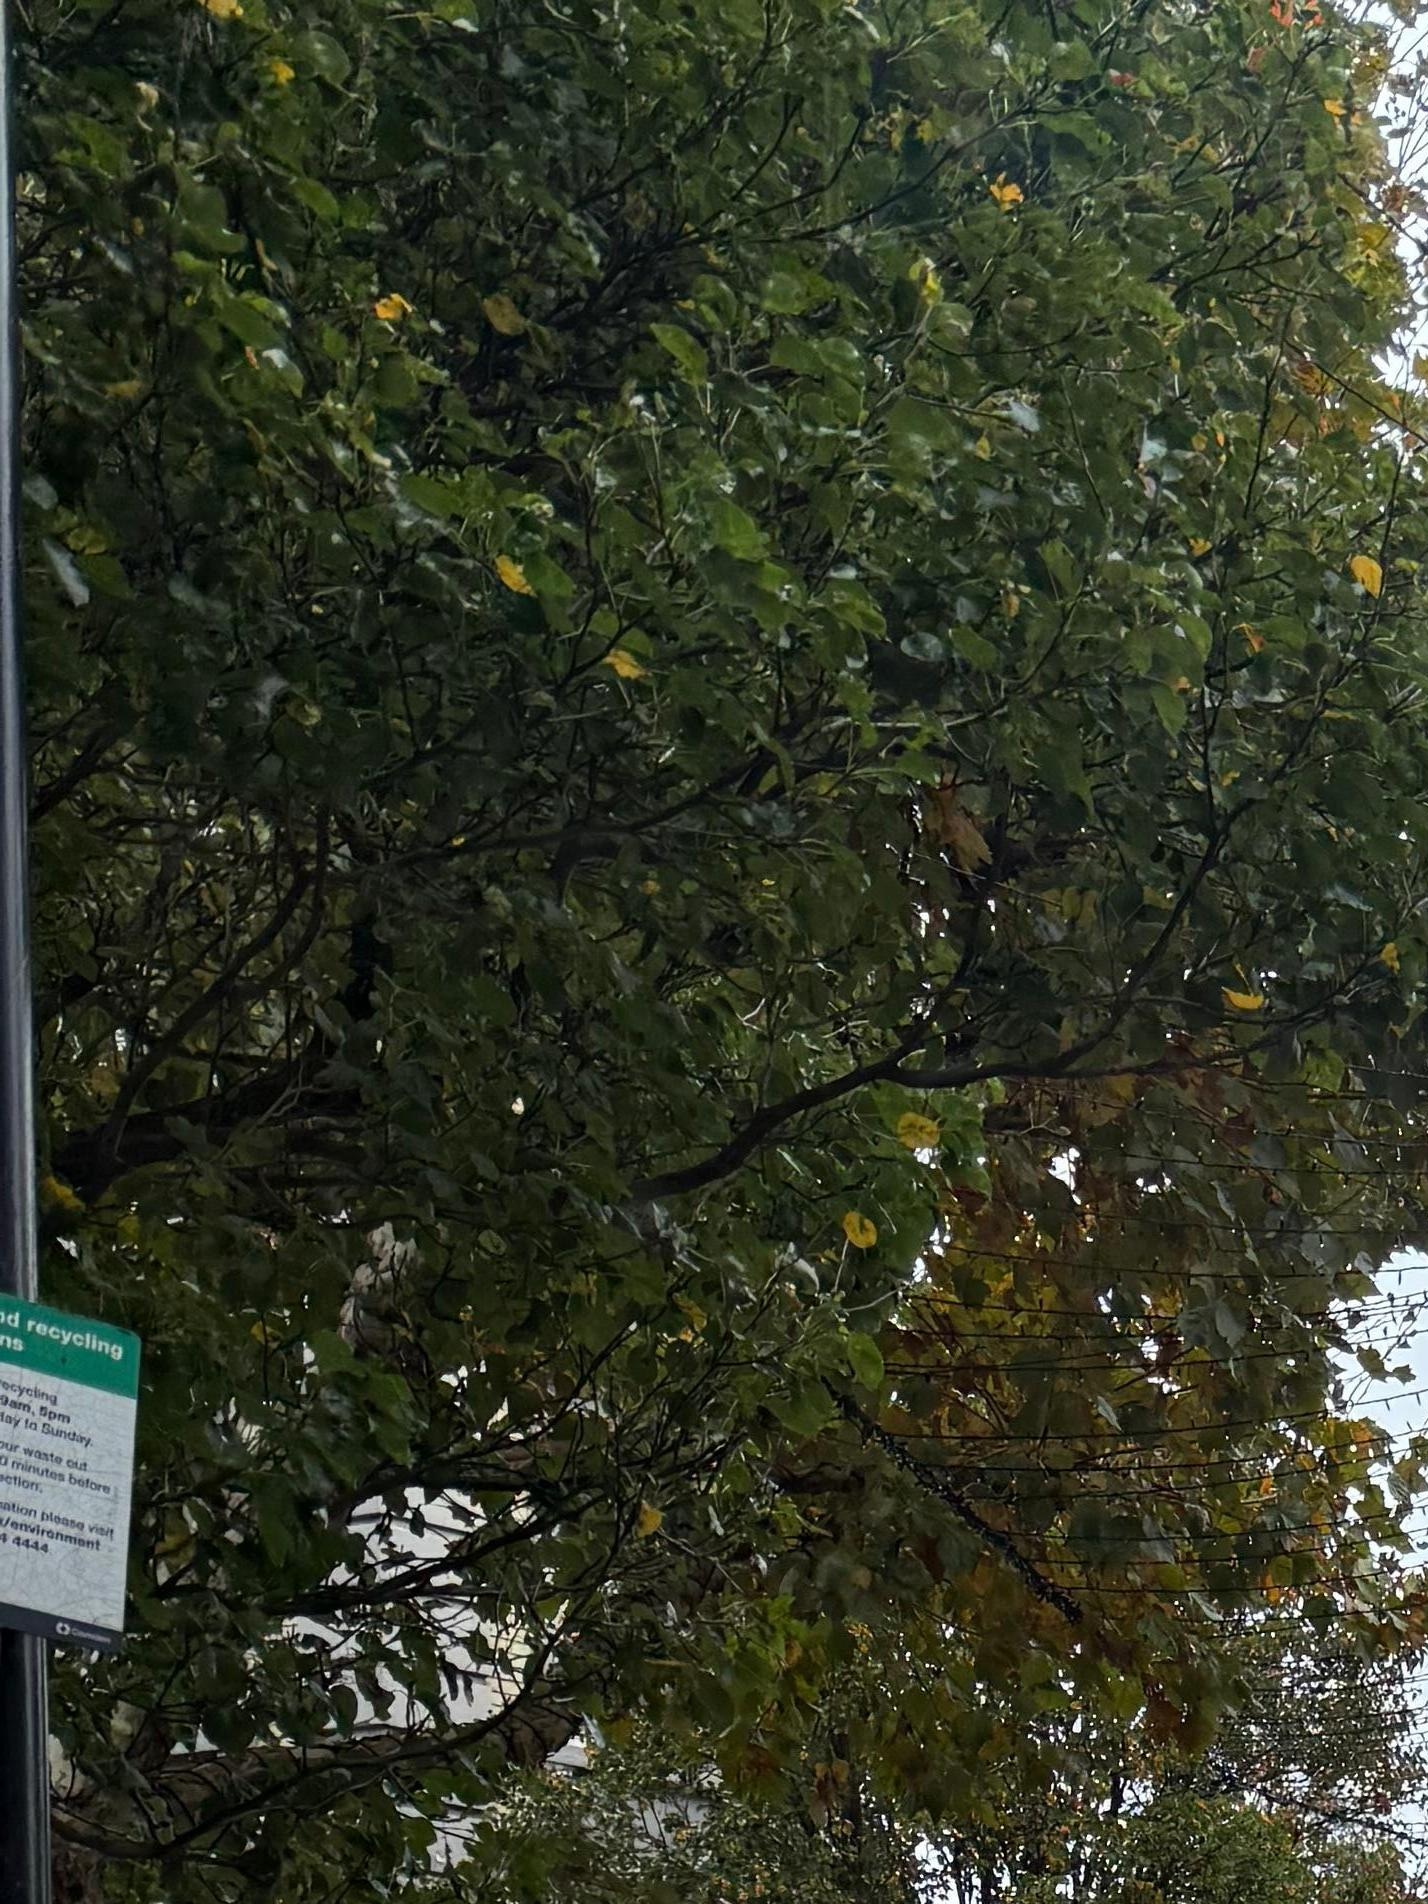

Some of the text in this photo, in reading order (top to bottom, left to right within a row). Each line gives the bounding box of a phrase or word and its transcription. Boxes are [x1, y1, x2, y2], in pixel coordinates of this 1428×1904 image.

[27, 1319, 124, 1361] recycling
[42, 1423, 94, 1448] Sunday.
[0, 1440, 88, 1472] our waste out
[12, 1459, 66, 1483] minutes
[69, 1473, 111, 1495] before
[0, 1517, 101, 1551] /environment
[41, 1511, 85, 1533] please
[12, 1535, 50, 1554] 4444
